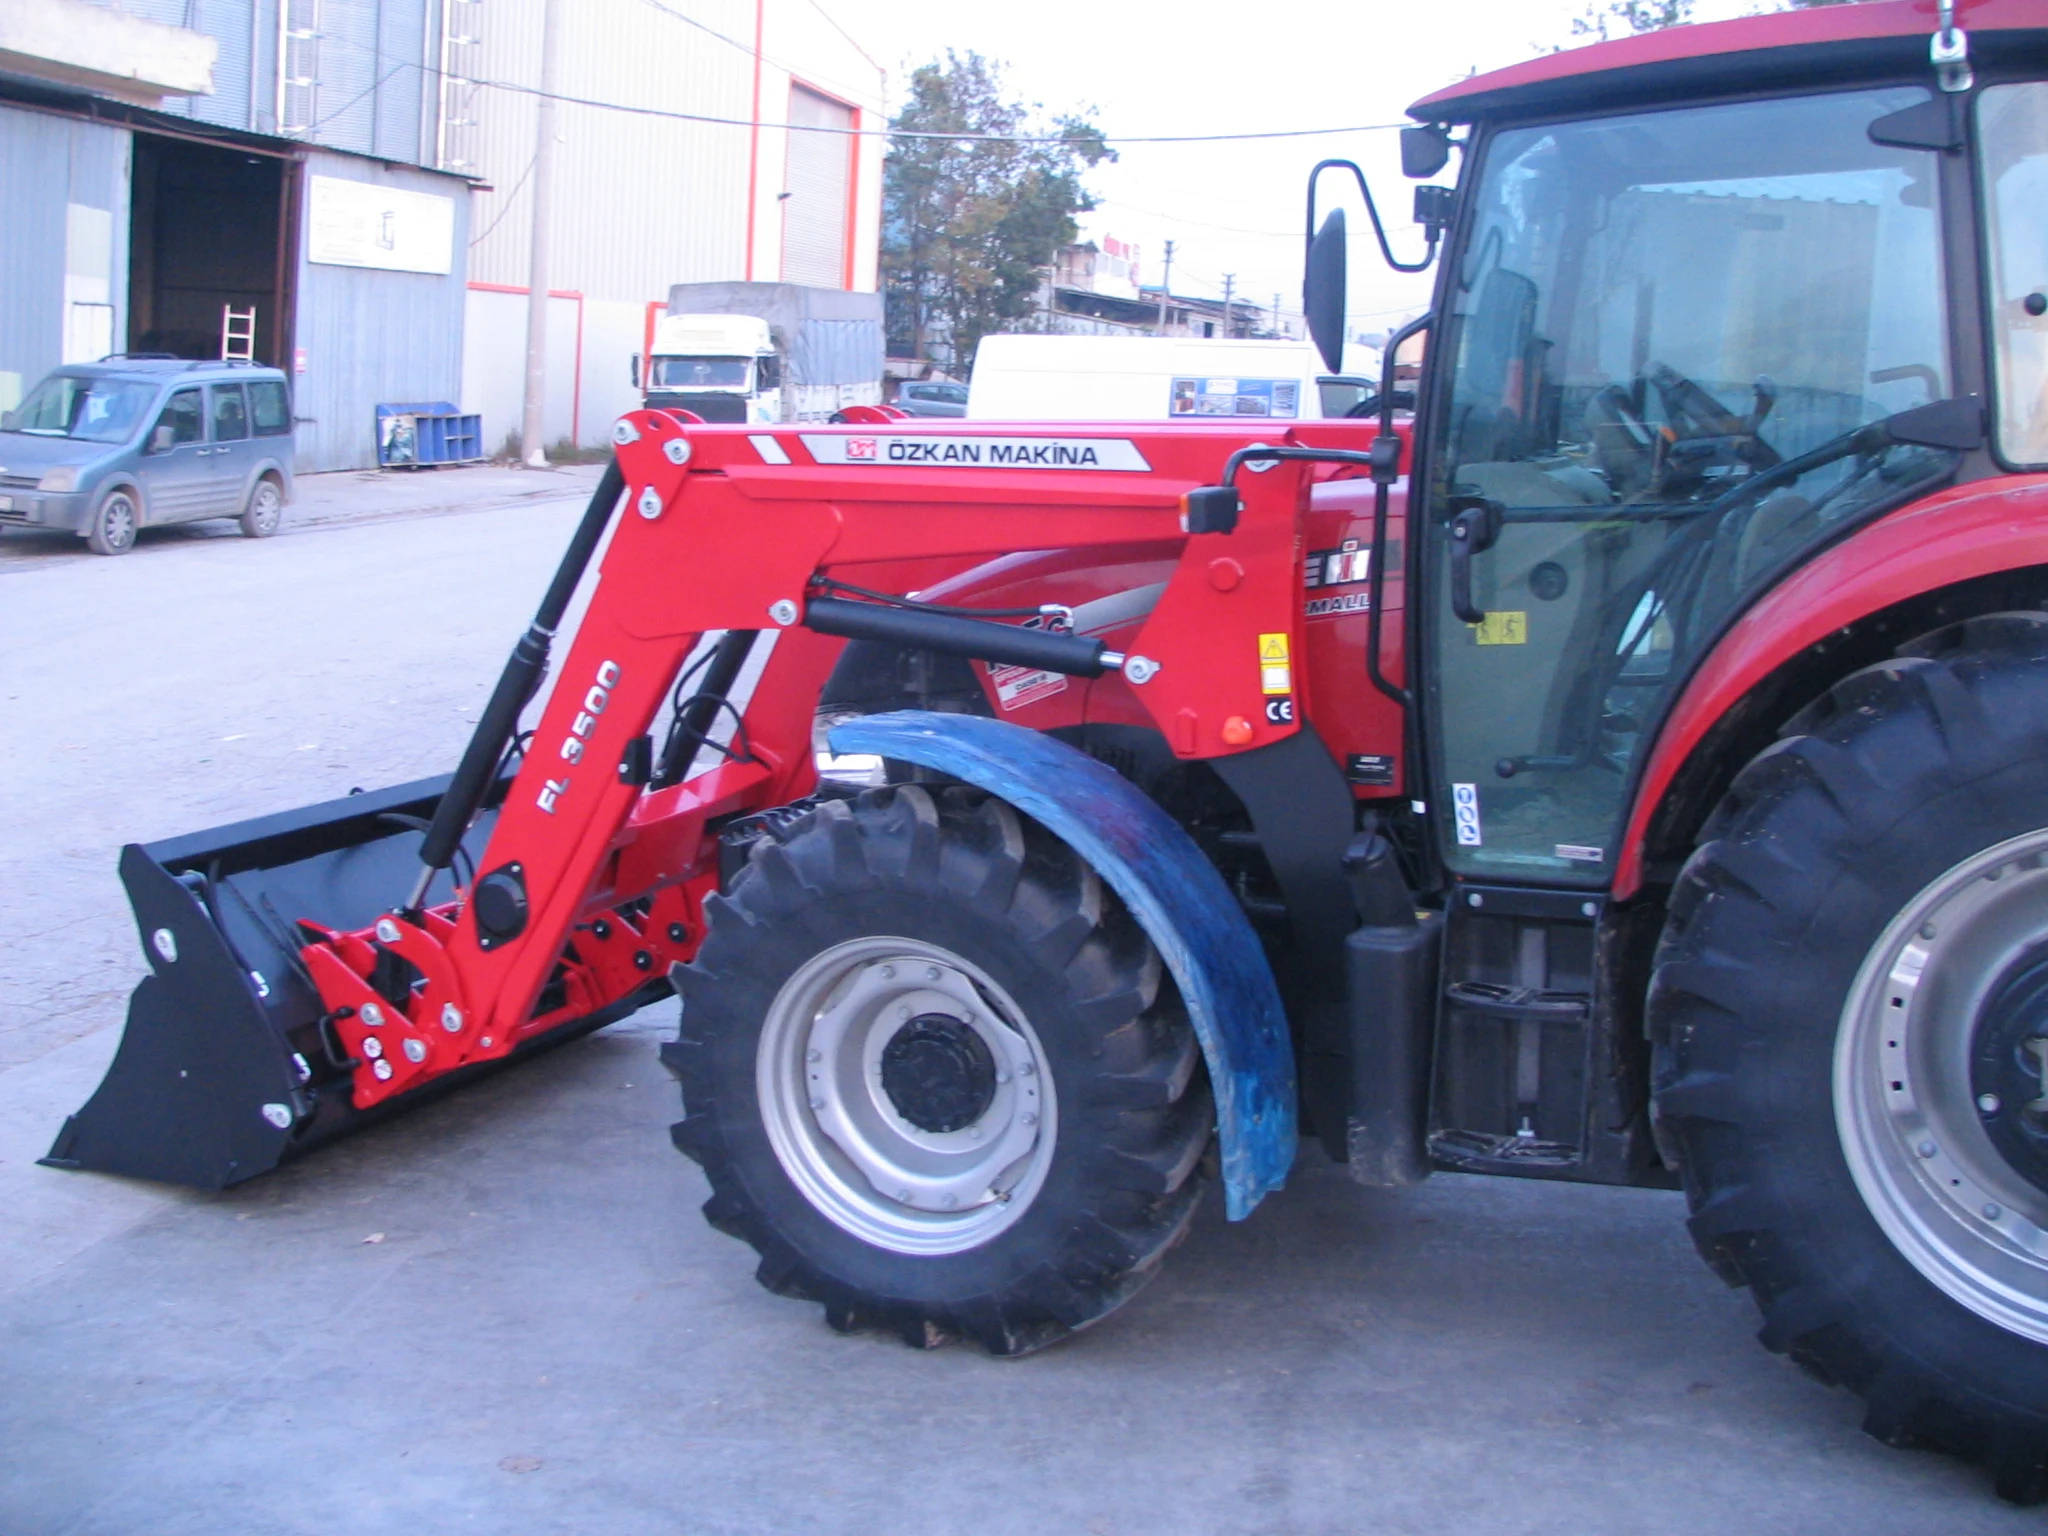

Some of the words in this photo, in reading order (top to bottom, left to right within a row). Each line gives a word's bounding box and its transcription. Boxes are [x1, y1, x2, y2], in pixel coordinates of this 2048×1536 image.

[888, 439, 980, 462] ÖZKAN
[989, 442, 1098, 466] MAKİNA
[1304, 593, 1371, 616] MALL
[1266, 701, 1292, 720] CE
[536, 777, 571, 814] FL
[560, 660, 621, 765] 3500
